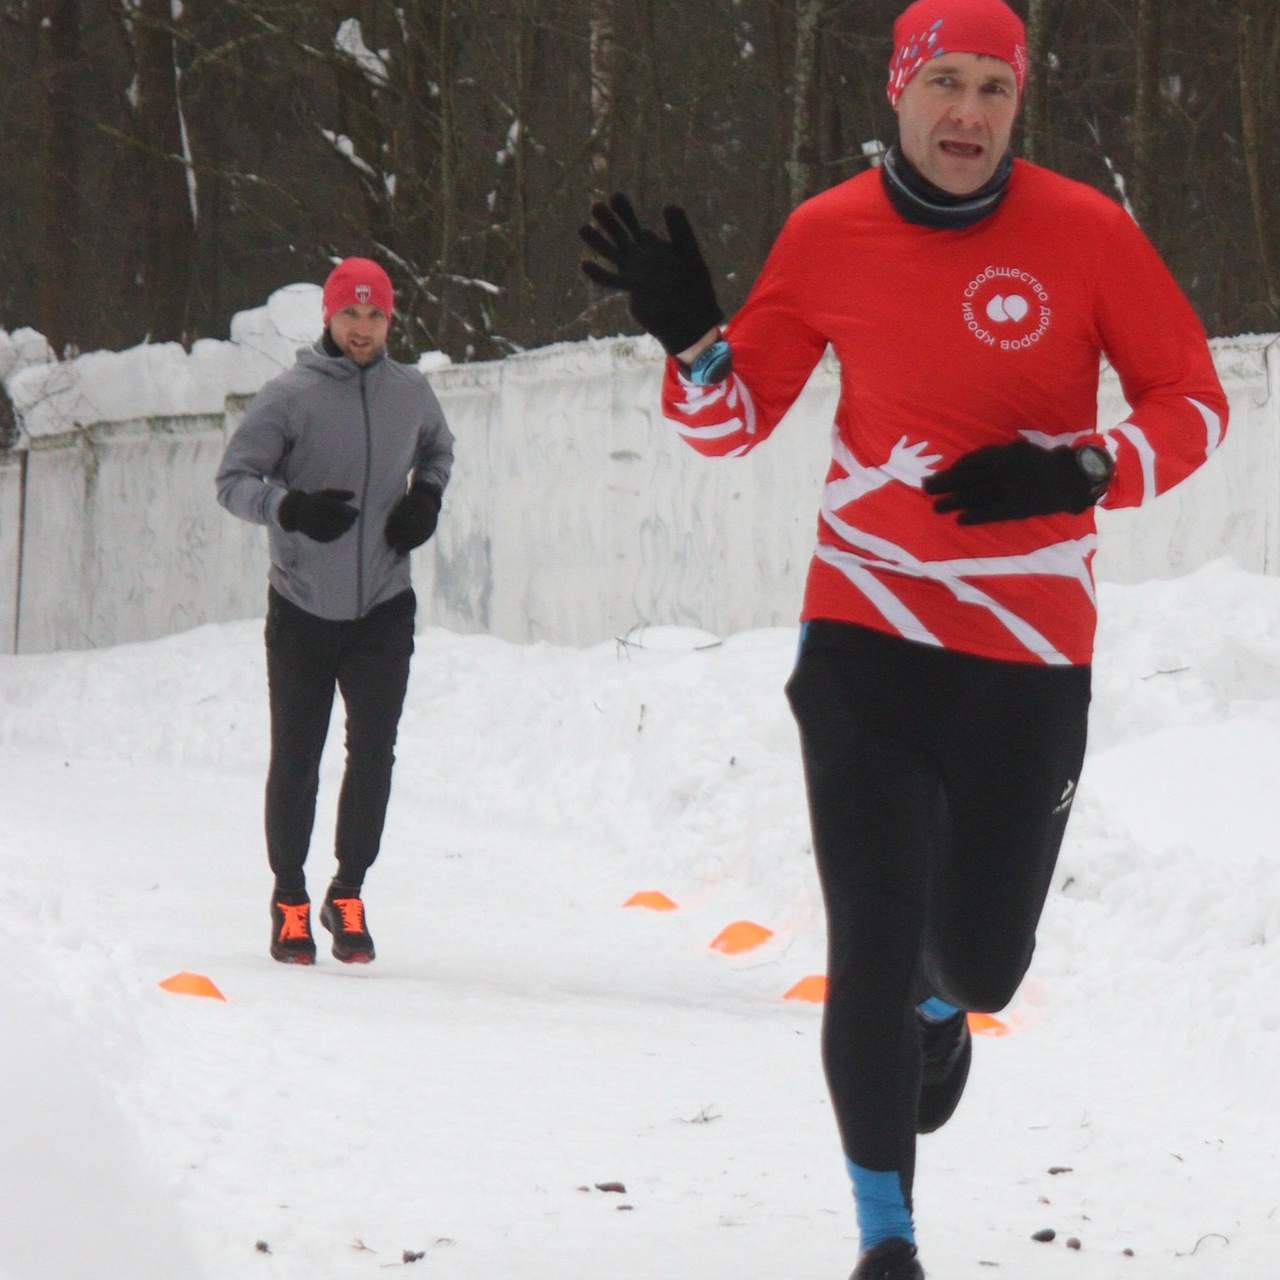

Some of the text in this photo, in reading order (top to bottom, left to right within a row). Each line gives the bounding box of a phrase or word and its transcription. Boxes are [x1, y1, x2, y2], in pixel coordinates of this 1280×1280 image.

[962, 265, 1051, 350] сообщество доноров крови
